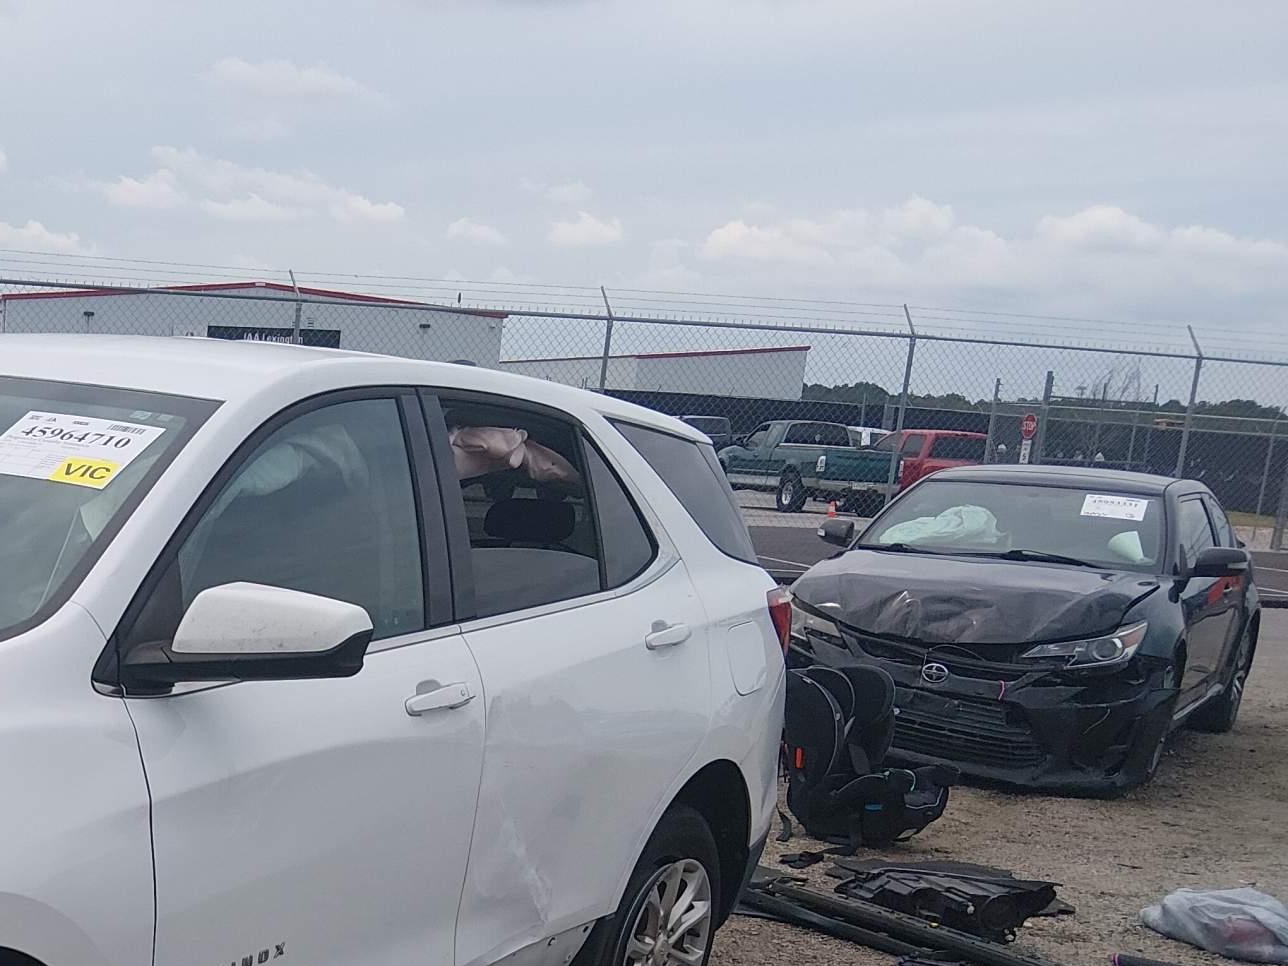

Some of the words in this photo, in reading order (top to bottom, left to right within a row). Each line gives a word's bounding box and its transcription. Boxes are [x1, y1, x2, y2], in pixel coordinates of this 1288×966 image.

[262, 332, 304, 344] Lexingtn
[1022, 421, 1037, 431] STOP
[21, 425, 132, 449] 45964710
[64, 463, 111, 480] VIC
